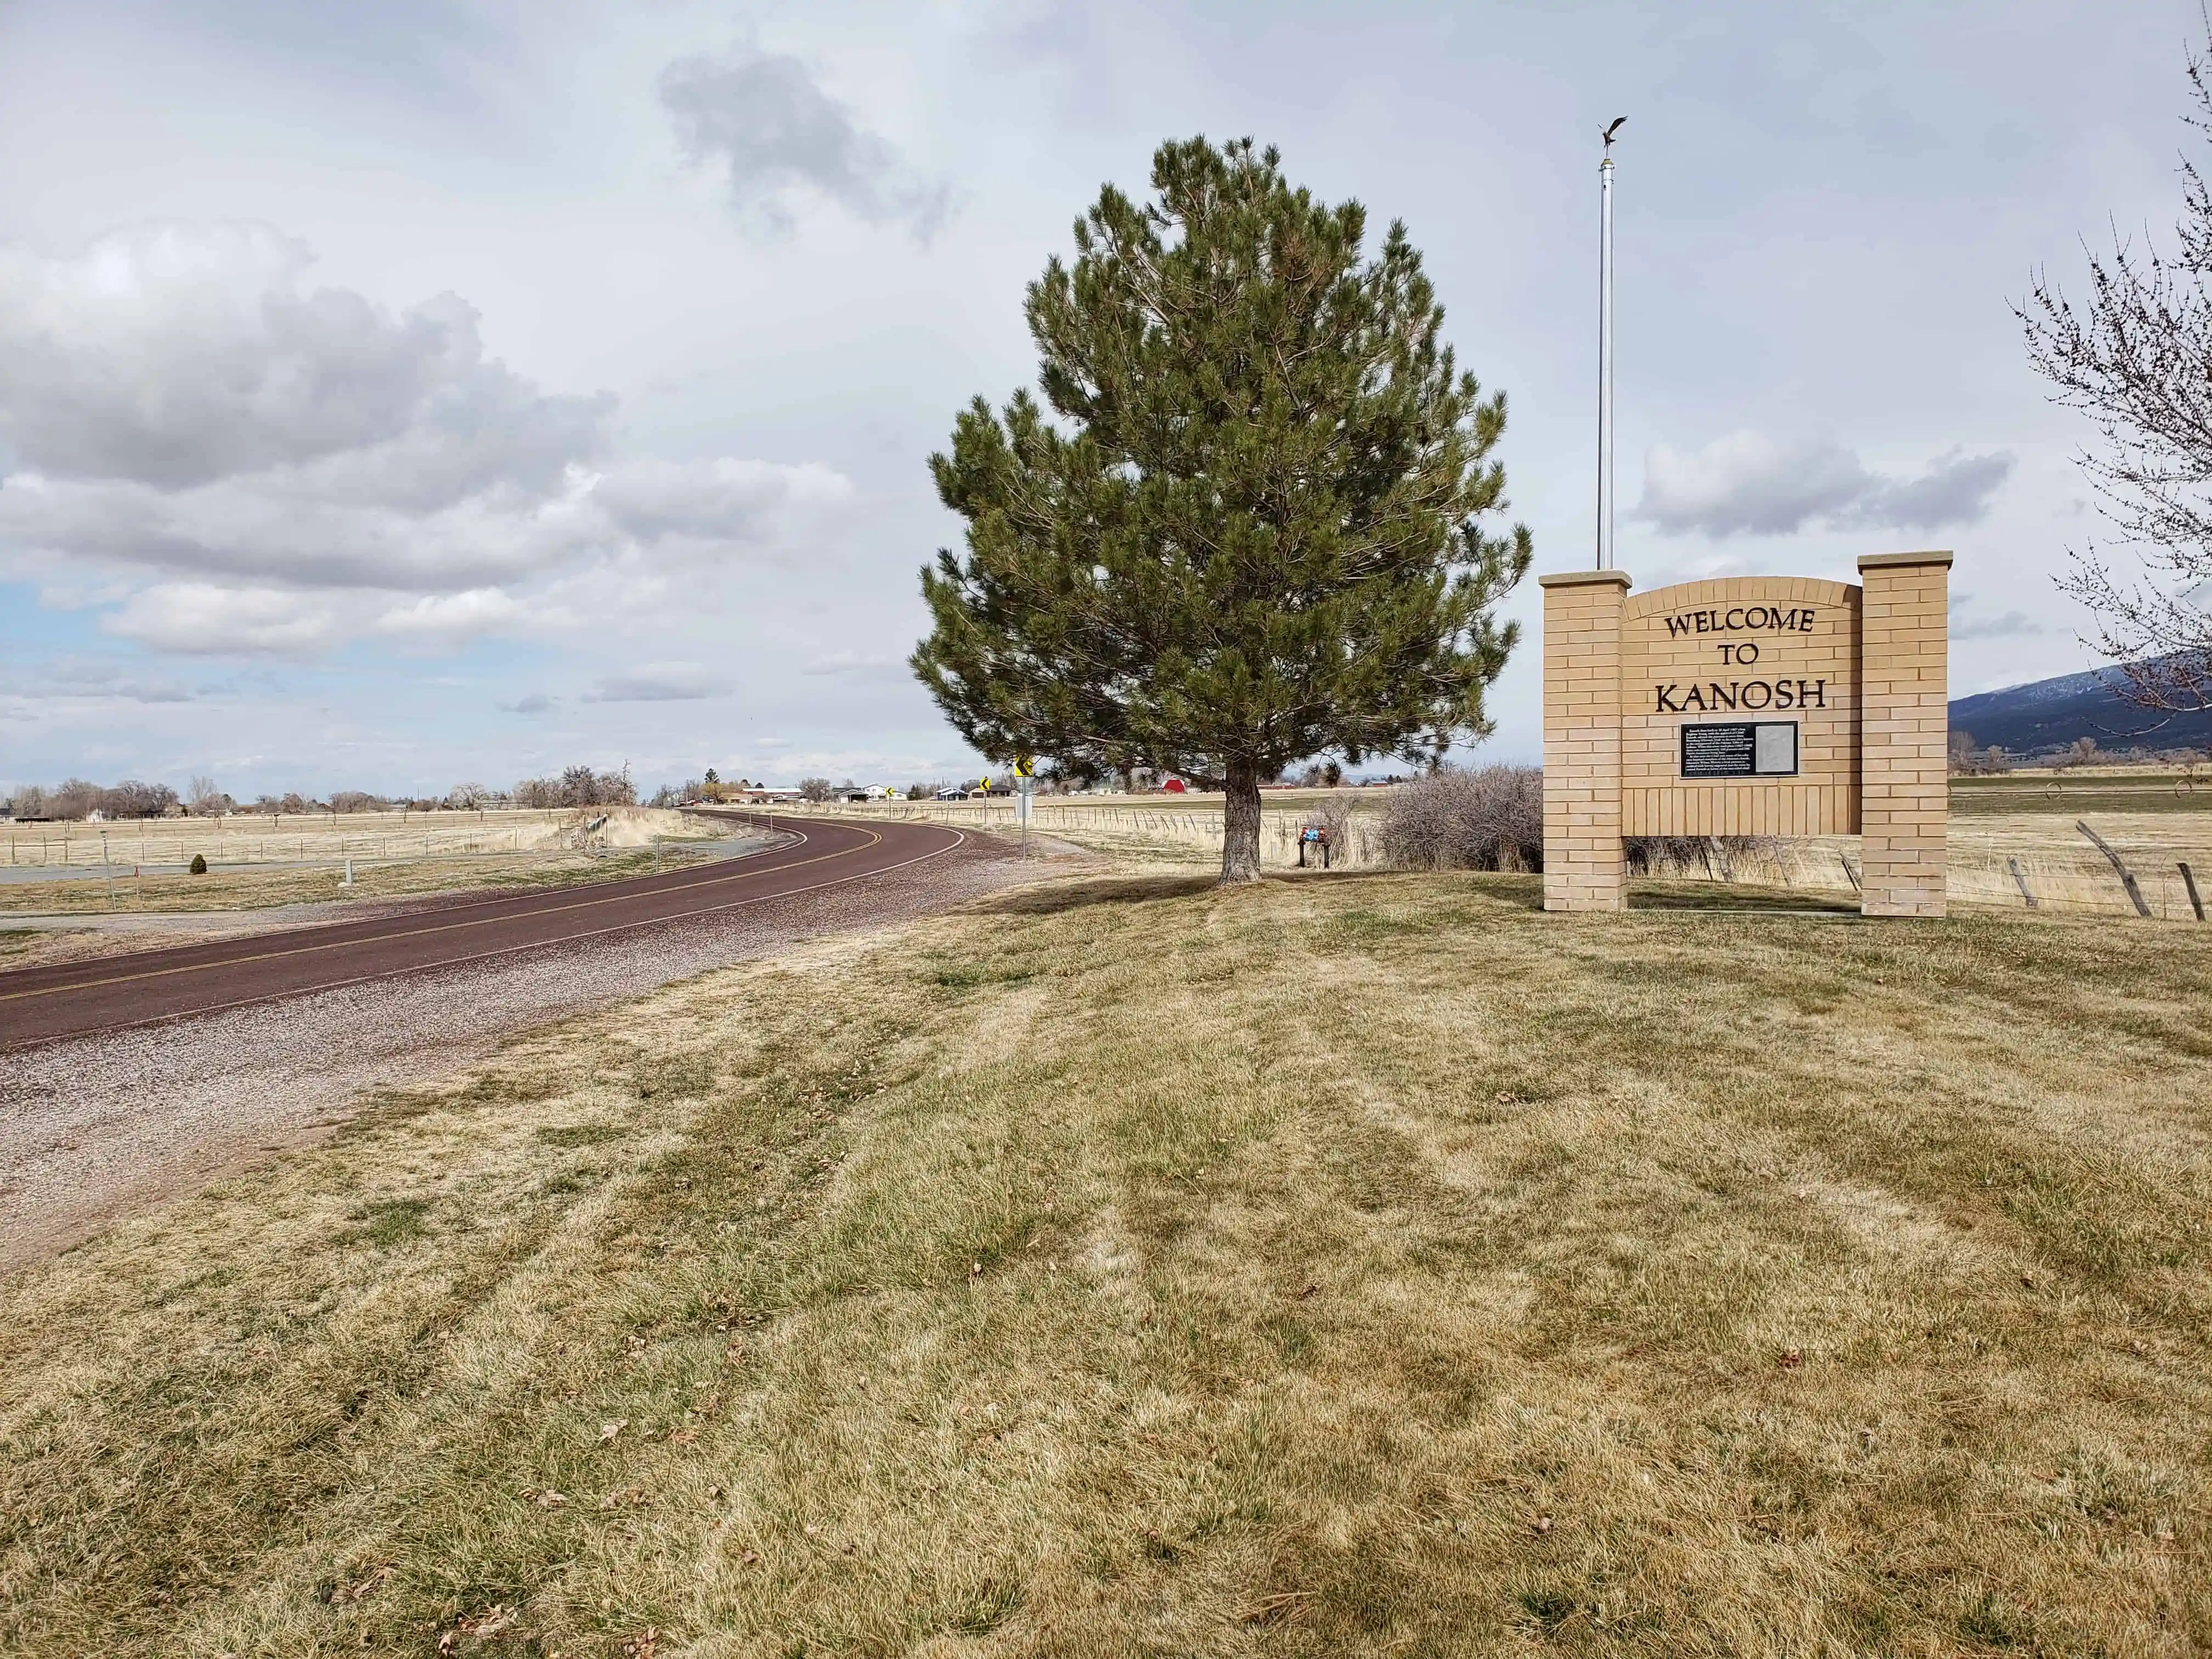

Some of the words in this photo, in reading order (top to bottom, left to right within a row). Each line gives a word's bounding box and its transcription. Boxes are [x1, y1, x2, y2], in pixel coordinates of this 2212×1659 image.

[1665, 607, 1815, 638] WELCOME
[1718, 643, 1759, 665] TO
[1655, 680, 1826, 712] KANOSH
